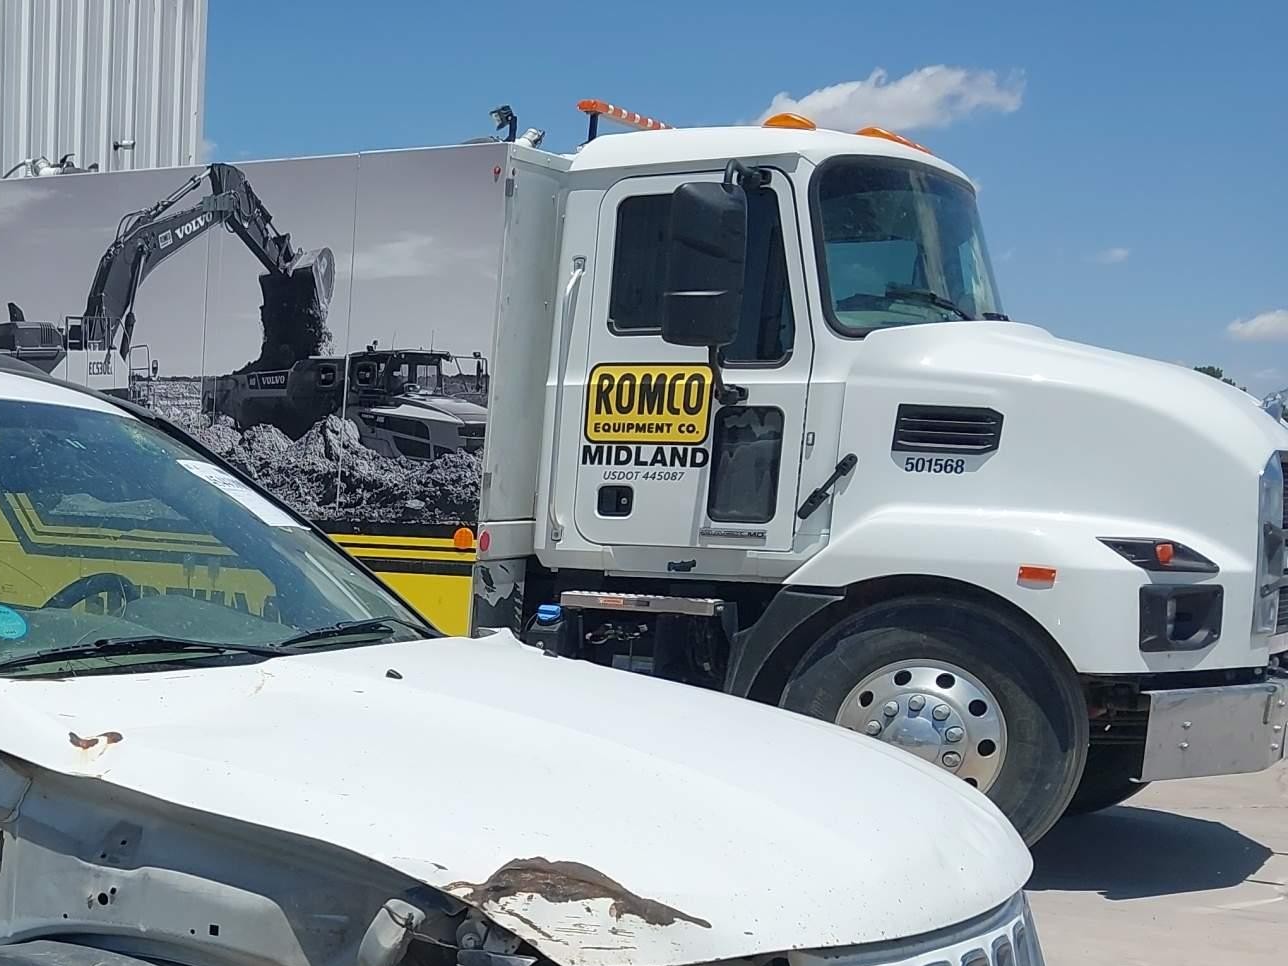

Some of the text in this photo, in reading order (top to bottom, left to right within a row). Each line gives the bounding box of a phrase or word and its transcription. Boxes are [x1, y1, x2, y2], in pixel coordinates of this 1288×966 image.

[175, 211, 212, 239] VOLVO
[262, 375, 285, 385] VOLVO
[594, 372, 706, 416] ROMCO
[593, 422, 700, 435] EQUIPMENT CO.
[581, 444, 710, 468] MIDLAND
[904, 456, 966, 475] 501568
[603, 470, 686, 481] USDOT 445087
